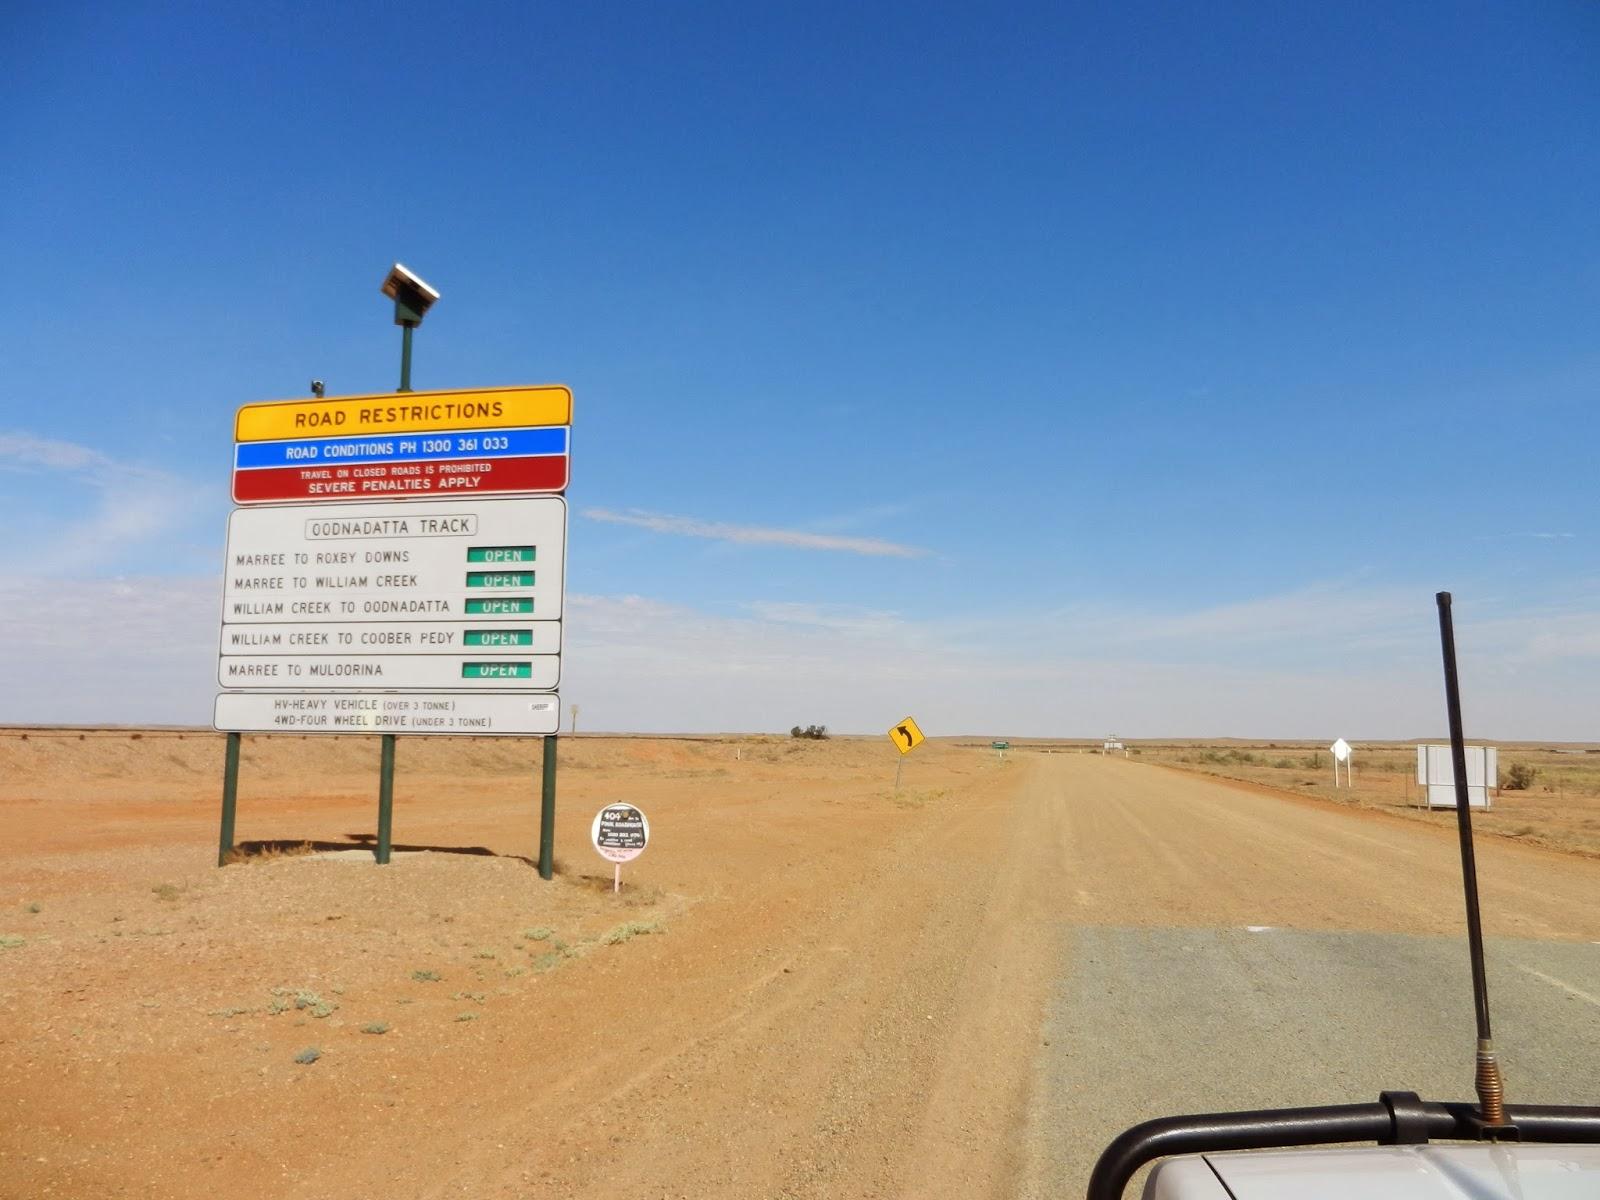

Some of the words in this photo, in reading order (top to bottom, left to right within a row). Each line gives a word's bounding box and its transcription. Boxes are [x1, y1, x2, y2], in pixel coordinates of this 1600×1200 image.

[296, 412, 346, 428] ROAD
[360, 402, 503, 423] RESTRICTIONS
[286, 447, 317, 459] ROAD
[324, 443, 393, 457] CONDITIONS
[400, 442, 416, 454] PH
[422, 439, 451, 452] 1300
[458, 438, 478, 450] 361
[483, 438, 508, 449] 033
[301, 470, 331, 479] TRAVEL
[353, 468, 386, 477] CLOSED
[392, 466, 420, 475] ROADS
[426, 465, 433, 473] IS
[439, 463, 491, 473] PROHIBITED
[308, 482, 355, 493] SEVERE
[363, 478, 431, 491] PENALTIES
[439, 477, 480, 488] APPLY
[312, 521, 408, 536] OODNADATTA
[421, 519, 469, 533] TRACK
[237, 554, 284, 566] MARREE
[294, 553, 308, 564] TO
[317, 552, 356, 564] ROXBY
[365, 551, 409, 562] DOWNS
[485, 551, 521, 562] OPEN
[235, 578, 283, 589] MARREE
[293, 577, 307, 588] TO
[316, 576, 368, 588] WILLIAM
[377, 575, 417, 587] CREEK
[484, 575, 521, 586] OPEN
[234, 602, 283, 614] WILLIAM
[292, 602, 330, 613] CREEK
[341, 601, 355, 612] TO
[364, 600, 450, 612] OODNADATTA
[482, 601, 520, 612] OPEN
[232, 633, 281, 645] WILLIAM
[289, 633, 328, 644] CREEK
[338, 632, 352, 644] TO
[361, 632, 411, 644] COOBER
[421, 632, 454, 644] PEDY
[481, 633, 519, 644] OPEN
[229, 664, 278, 676] MARREE
[288, 664, 302, 676] TO
[310, 664, 382, 676] MULOORINA
[480, 665, 518, 676] OPEN
[274, 700, 328, 710] HV-HEAVY
[334, 700, 378, 710] VEHICLE
[383, 701, 408, 710] (OVER
[413, 702, 418, 710] 3
[423, 702, 456, 711] TONNE)
[274, 716, 328, 726] 4WD-FOUR
[334, 716, 369, 726] WHEEL
[375, 716, 407, 726] DRIVE
[412, 717, 445, 727] (UNDER
[449, 718, 454, 726] 3
[459, 718, 491, 727] TONNE)
